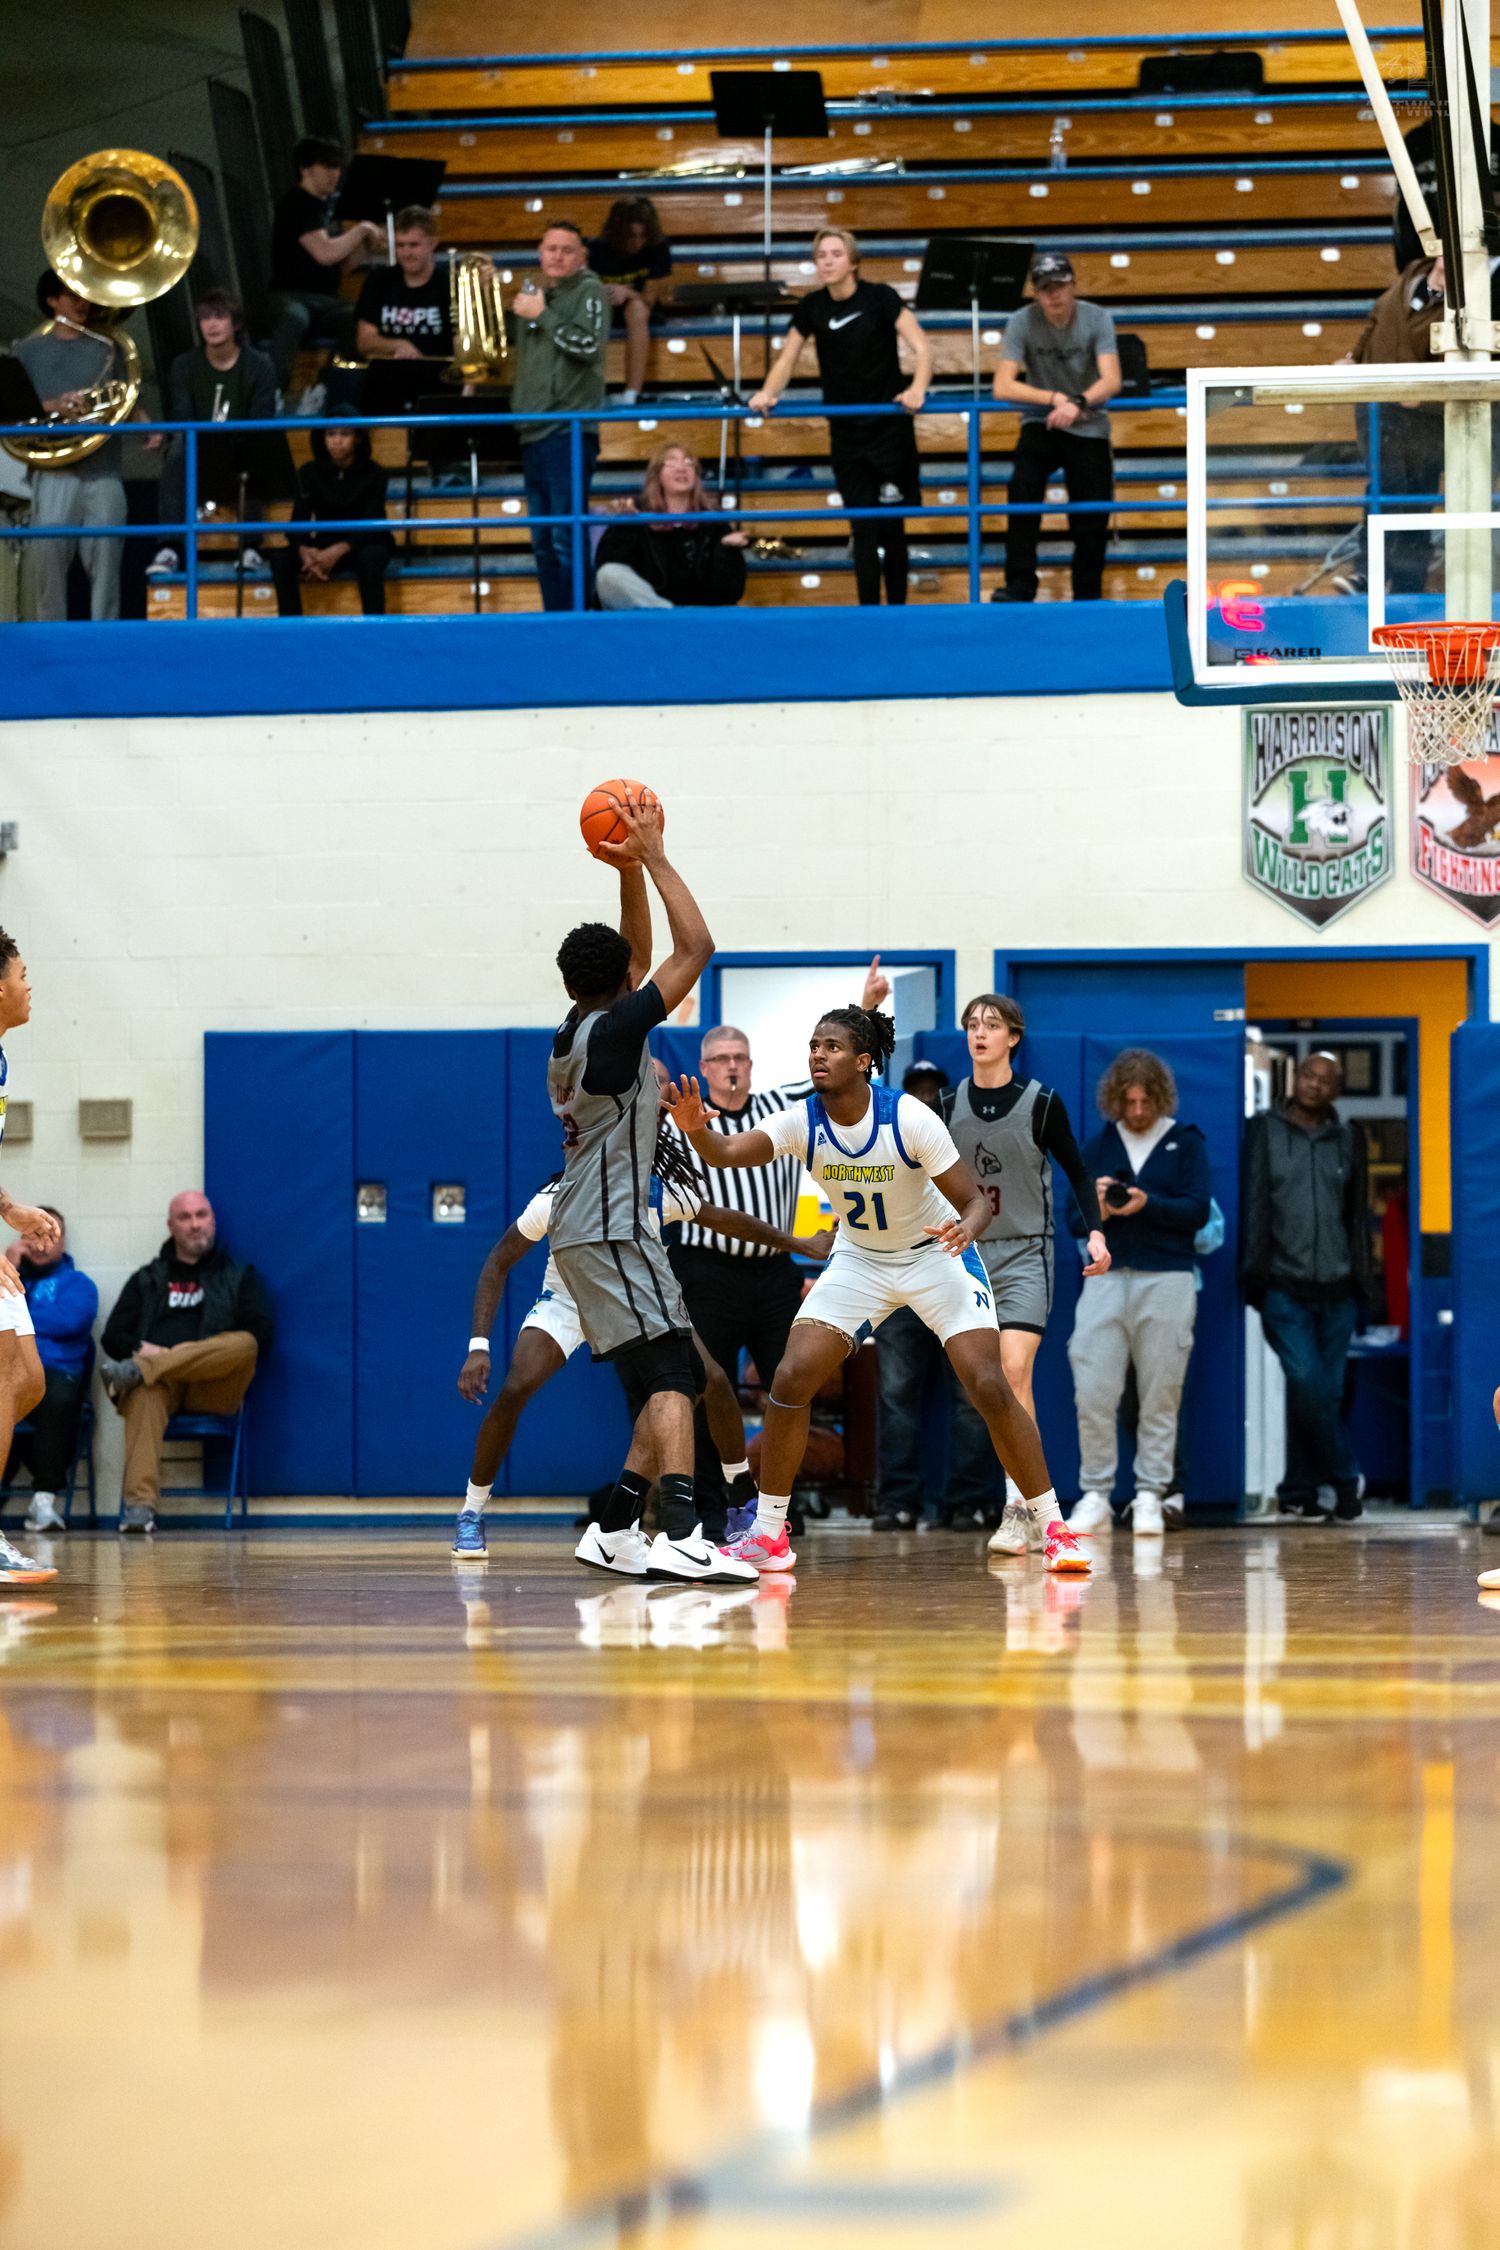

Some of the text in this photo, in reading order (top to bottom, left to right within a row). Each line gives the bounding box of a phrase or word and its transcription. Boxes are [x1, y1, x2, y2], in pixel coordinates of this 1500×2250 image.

[381, 305, 441, 326] HOPE
[1256, 647, 1321, 657] GARED
[1251, 712, 1384, 802] HARRISON
[1251, 820, 1387, 898] WILDCATS
[823, 1164, 895, 1184] NORTHWEST
[843, 1191, 888, 1231] 21
[973, 1291, 990, 1309] N
